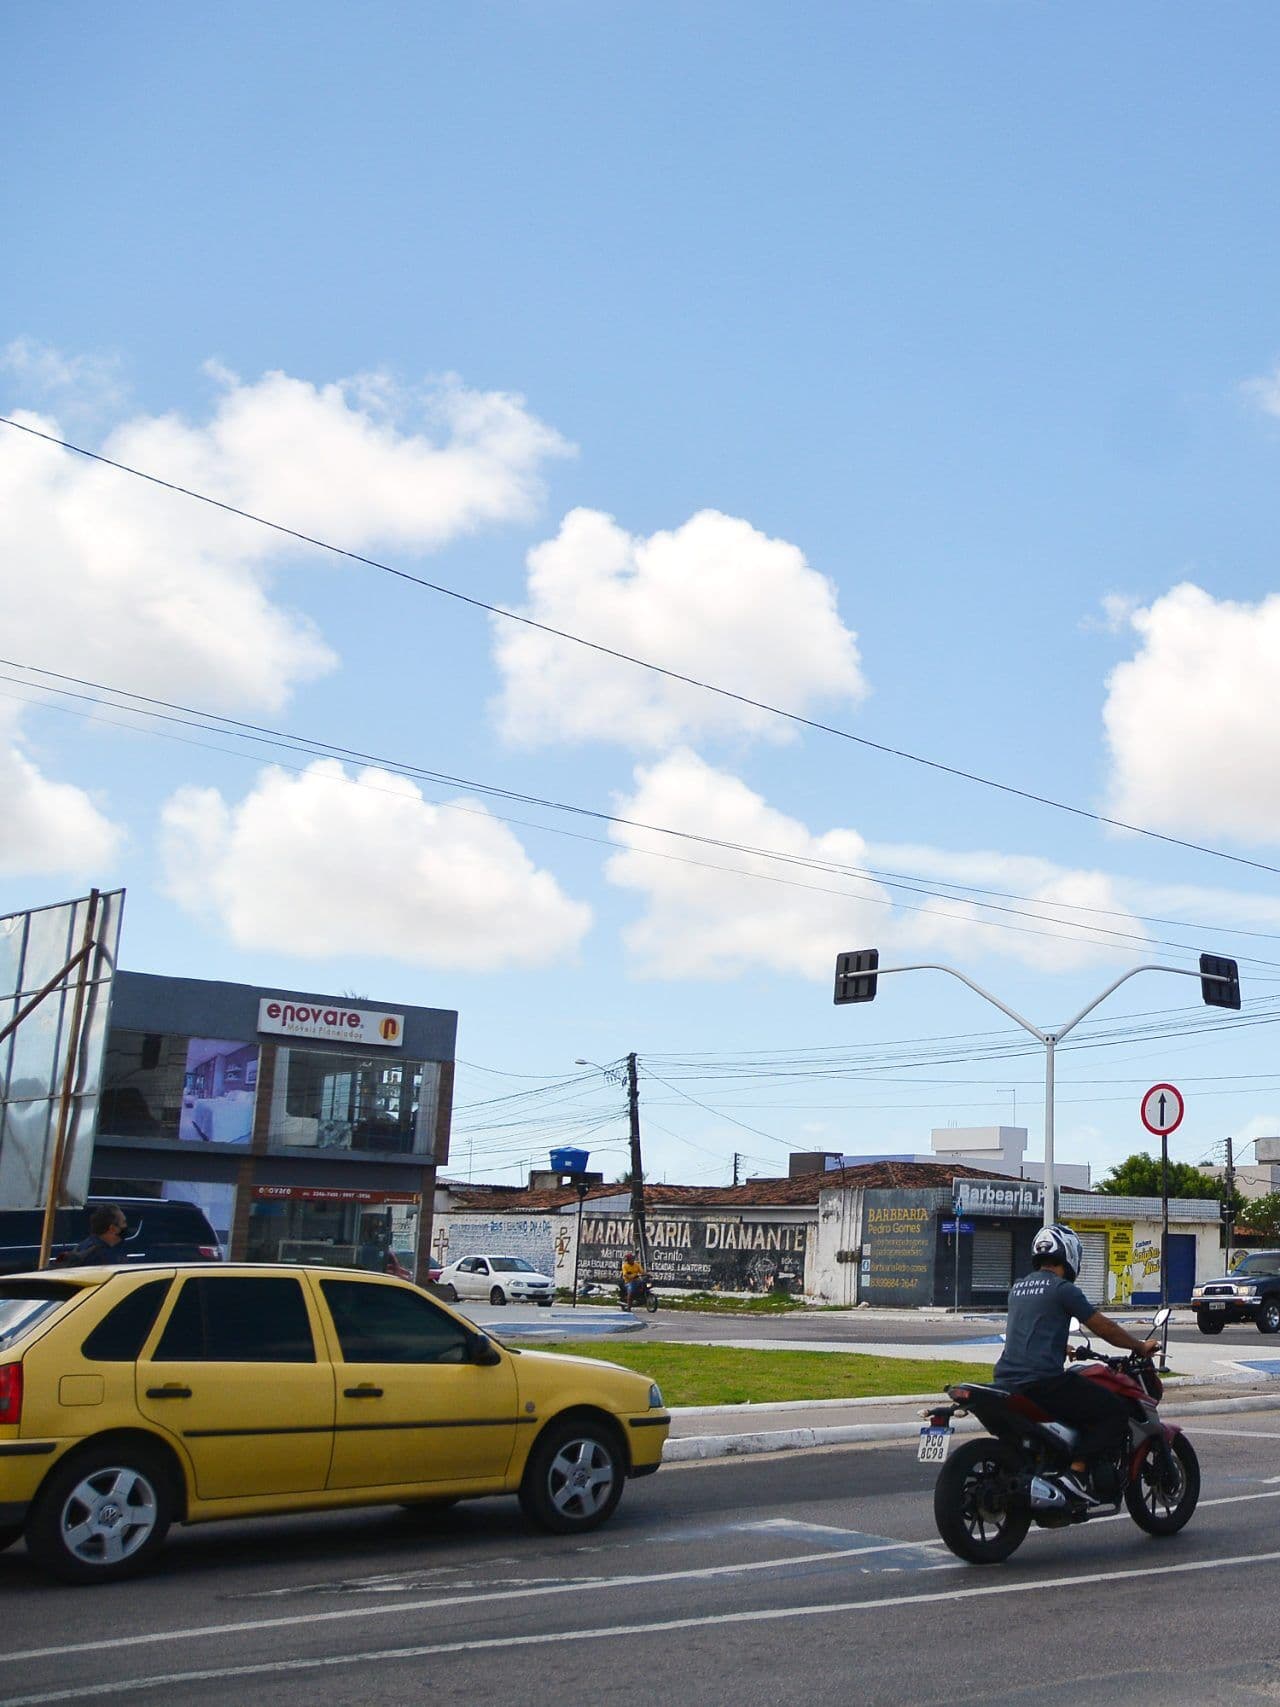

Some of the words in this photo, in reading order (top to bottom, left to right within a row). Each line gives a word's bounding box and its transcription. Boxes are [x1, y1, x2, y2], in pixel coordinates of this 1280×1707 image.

[959, 1183, 1033, 1204] Barbearia
[867, 1207, 929, 1223] BARBEARIA
[867, 1223, 892, 1235] Pedro
[892, 1222, 921, 1234] Gomes
[705, 1223, 805, 1252] DIAMANTE
[653, 1249, 683, 1262] Granito
[1012, 1279, 1050, 1289] PERSONAL
[1012, 1288, 1044, 1297] TRAINER
